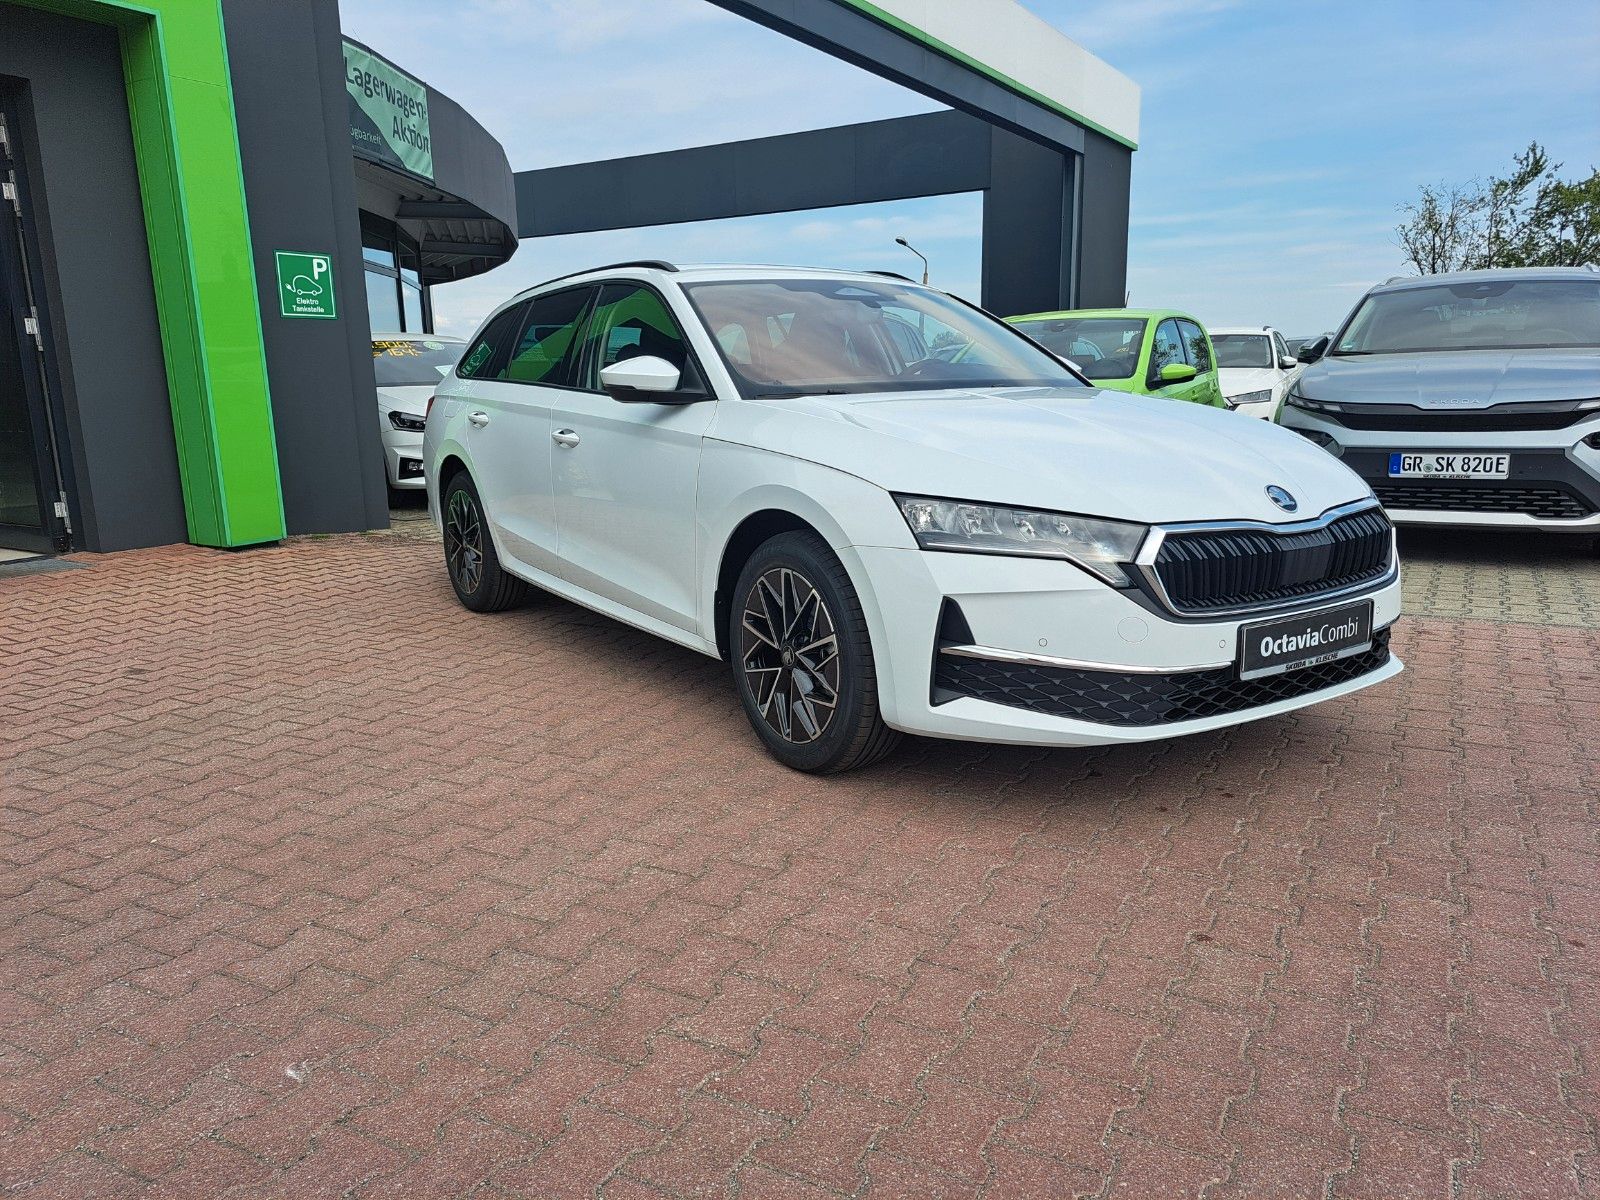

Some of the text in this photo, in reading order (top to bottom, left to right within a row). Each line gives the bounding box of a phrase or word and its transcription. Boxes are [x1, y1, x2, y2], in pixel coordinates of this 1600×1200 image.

[344, 57, 426, 119] Lagerwagen-
[392, 115, 430, 154] Aktion
[312, 258, 328, 280] P
[292, 305, 325, 313] Tankstelle
[296, 297, 319, 305] Elektro
[1401, 455, 1507, 474] GR SK 820E
[1260, 616, 1359, 658] OctaviaCombi
